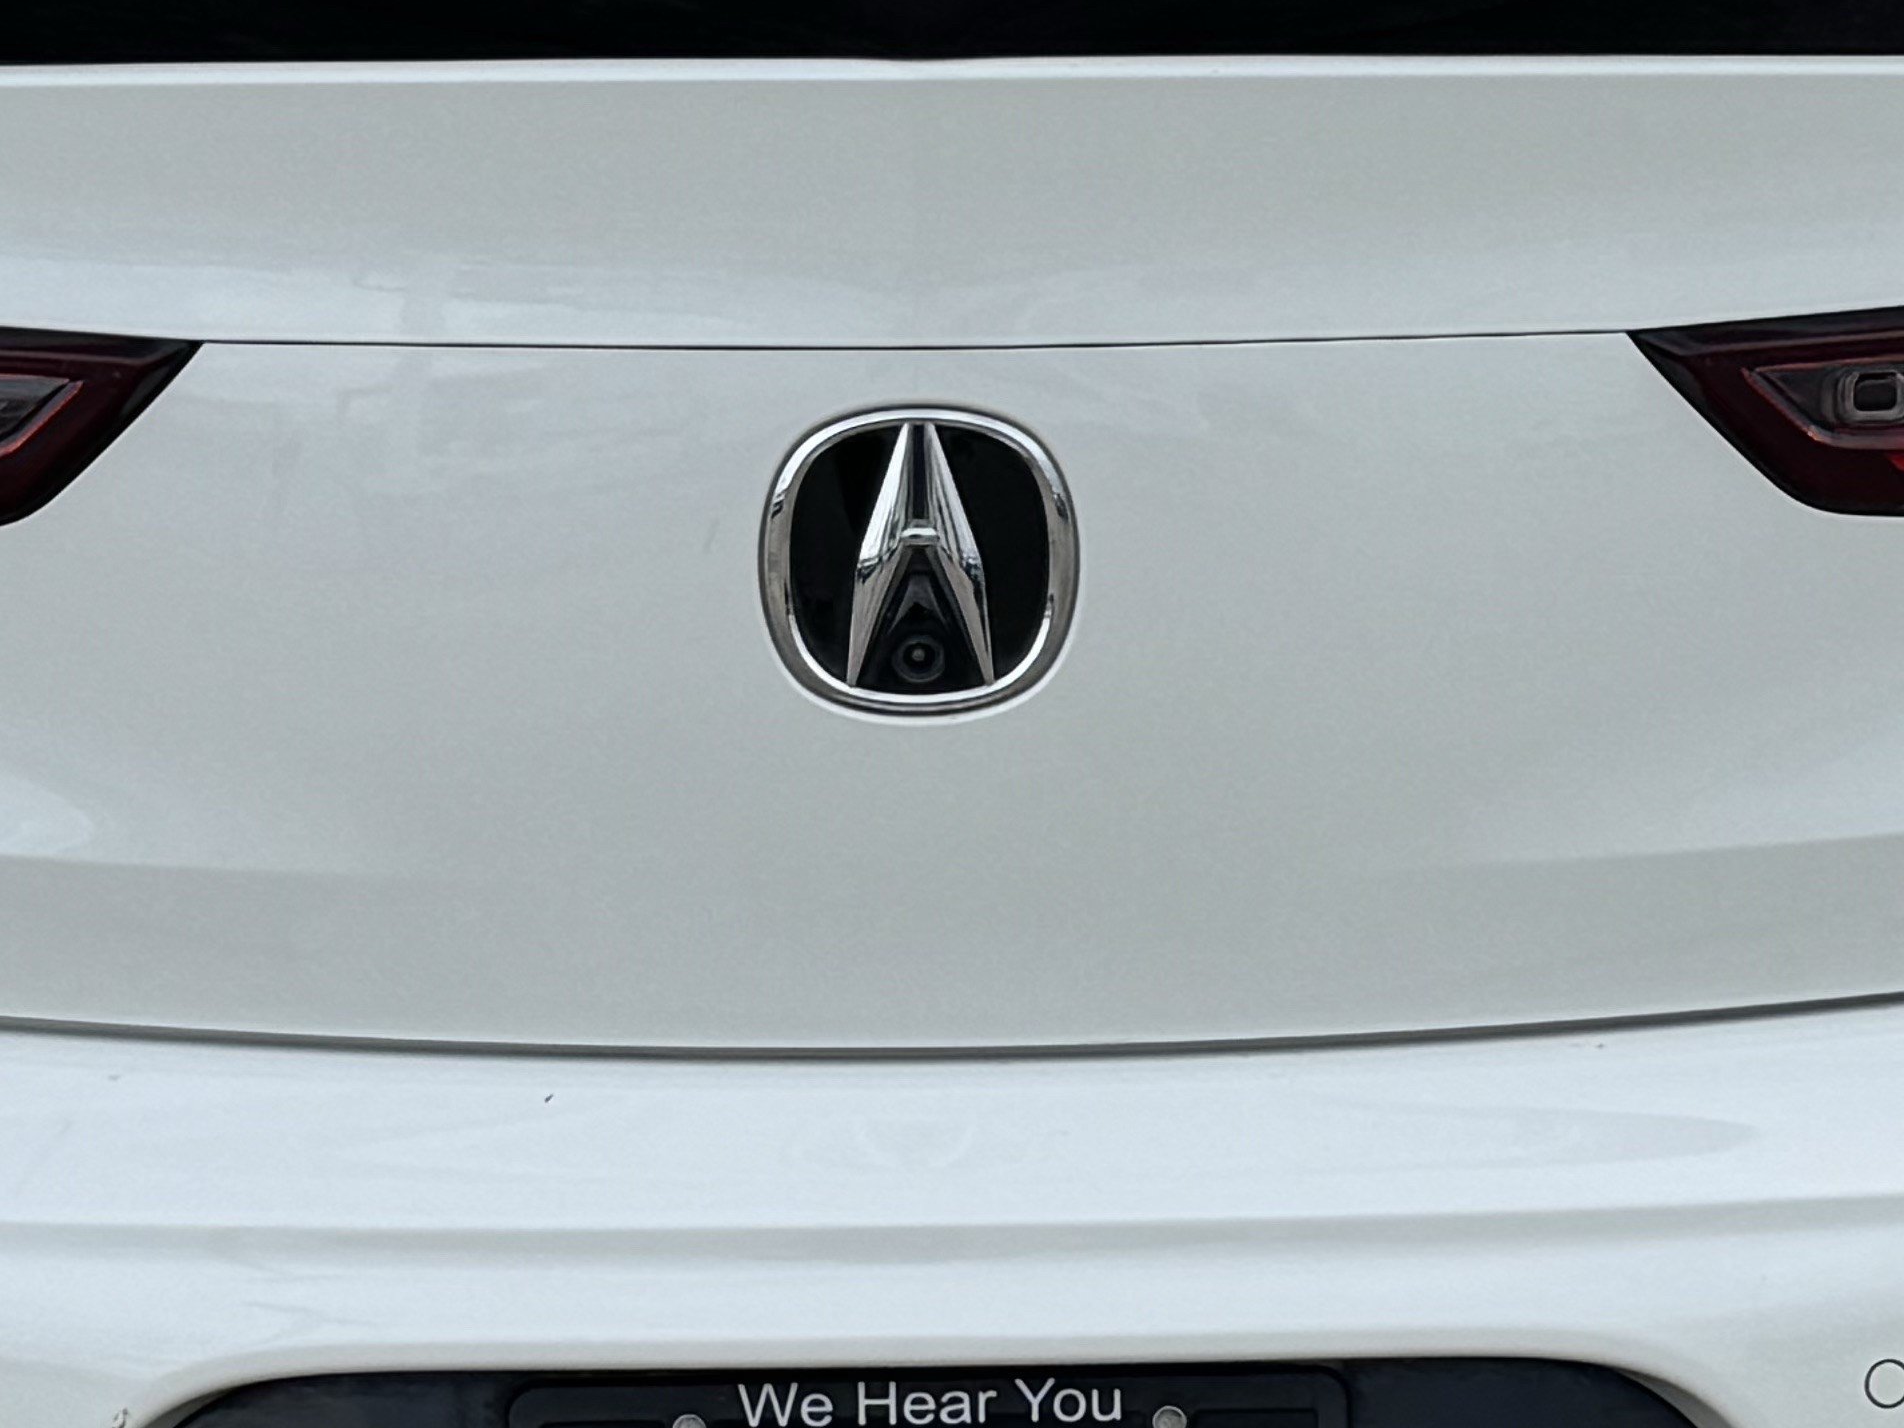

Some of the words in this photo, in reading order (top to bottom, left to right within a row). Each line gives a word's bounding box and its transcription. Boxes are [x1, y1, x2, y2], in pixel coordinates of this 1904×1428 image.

[737, 1382, 835, 1428] We
[856, 1381, 997, 1427] Hear
[1014, 1377, 1123, 1425] You
